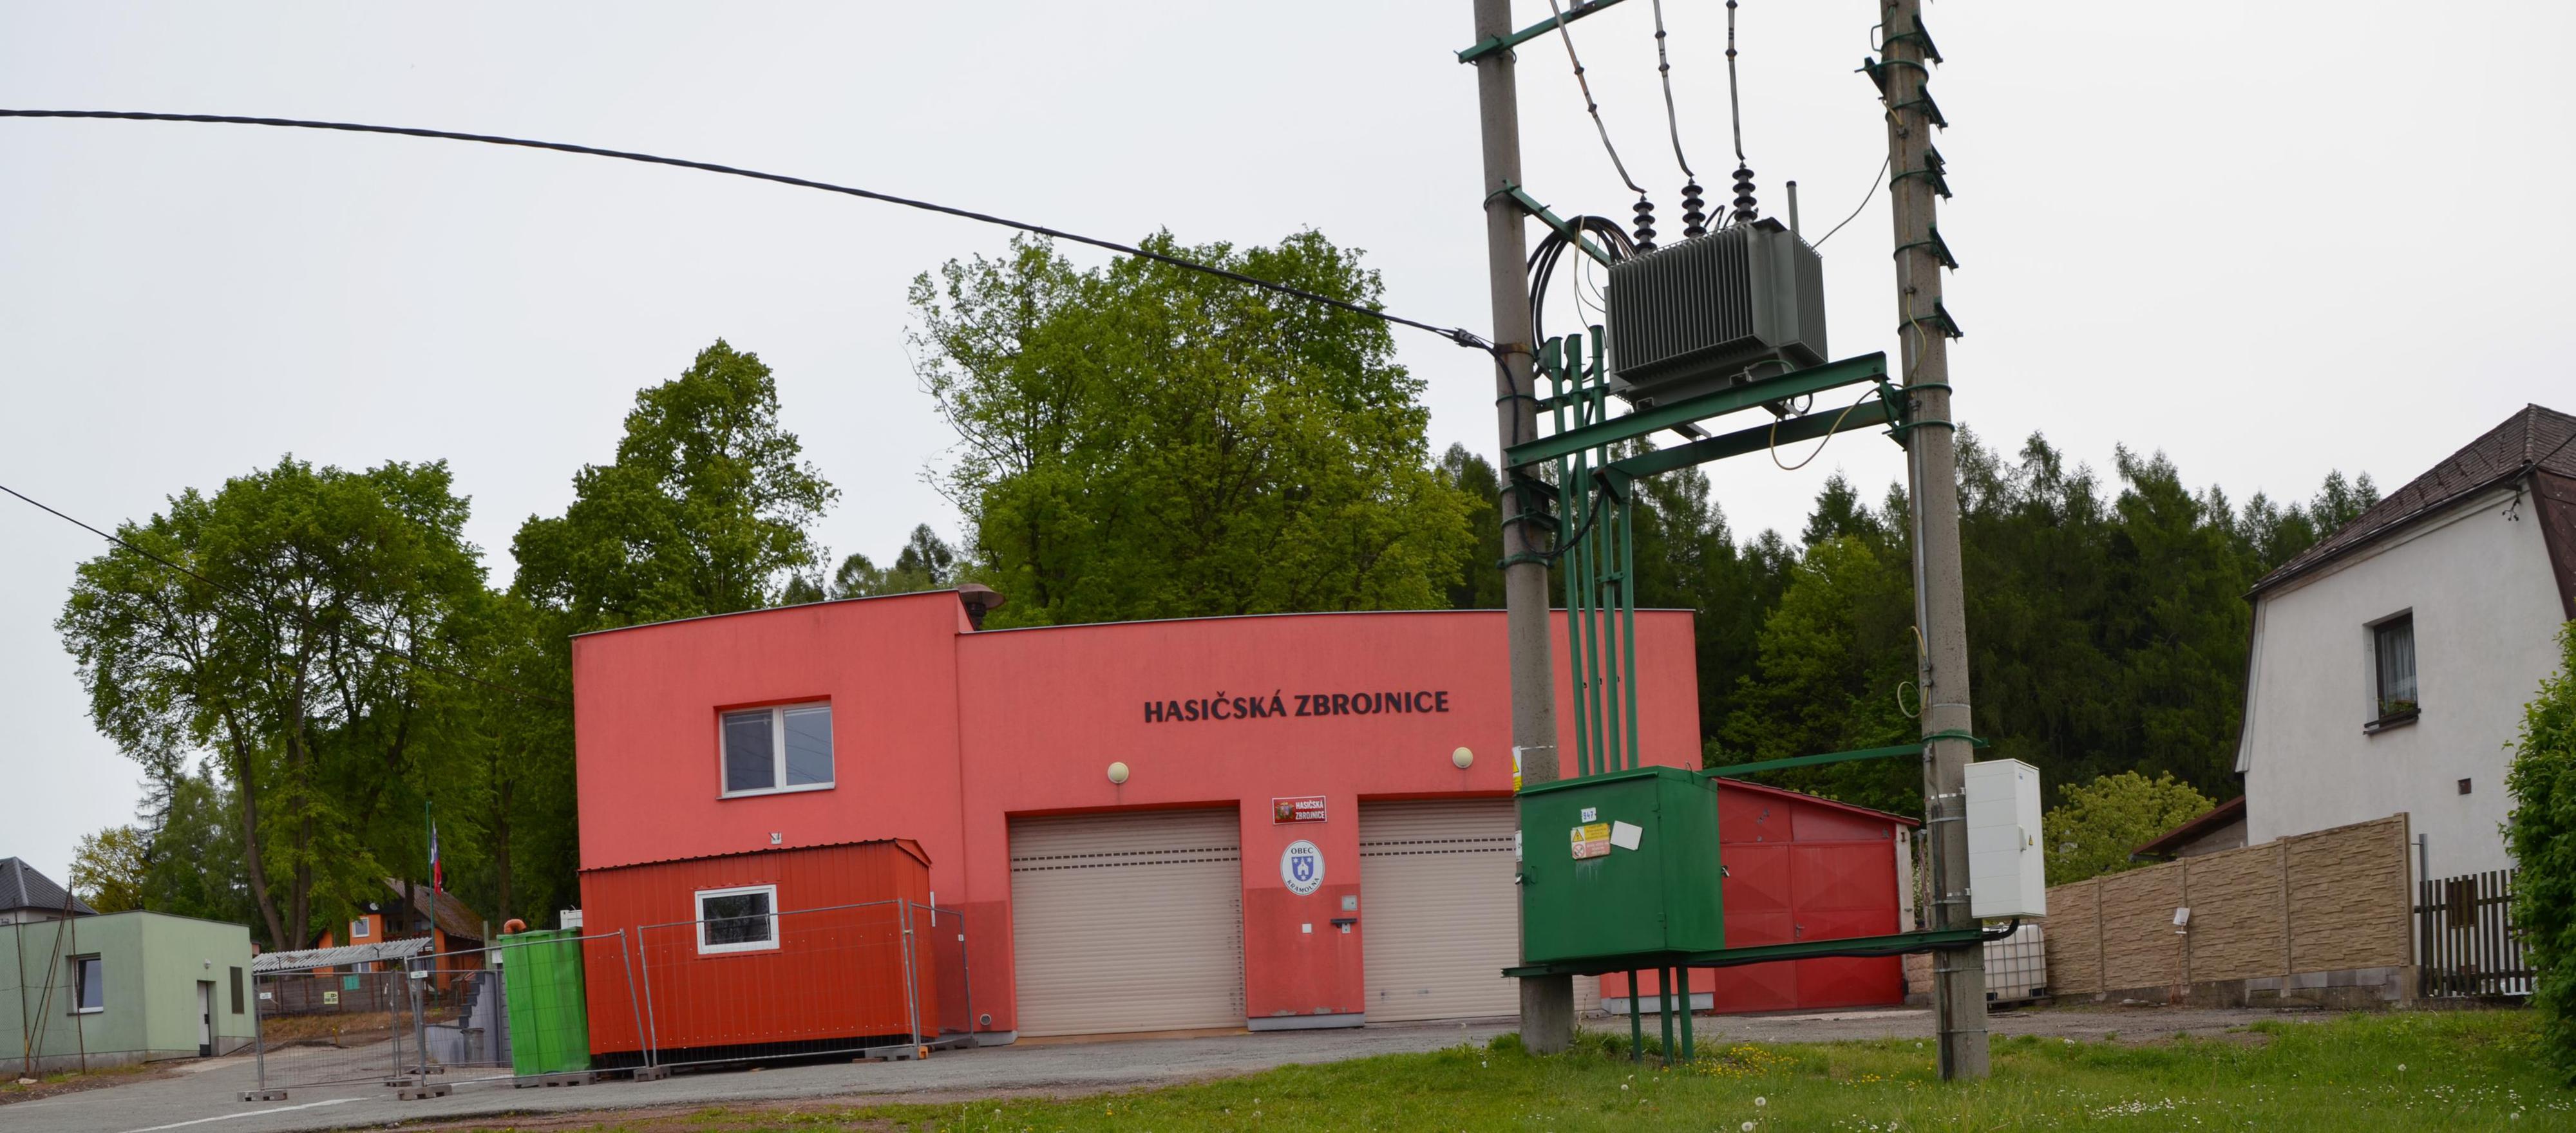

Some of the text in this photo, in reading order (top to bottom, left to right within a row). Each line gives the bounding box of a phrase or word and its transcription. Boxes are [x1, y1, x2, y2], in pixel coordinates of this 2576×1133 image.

[1144, 689, 1449, 723] HASIČSKÁ ZBROJNICE
[1296, 800, 1323, 809] HASIČSKÁ
[1296, 811, 1325, 819] ZBROJNICE
[1287, 878, 1319, 893] KRAMOLNA
